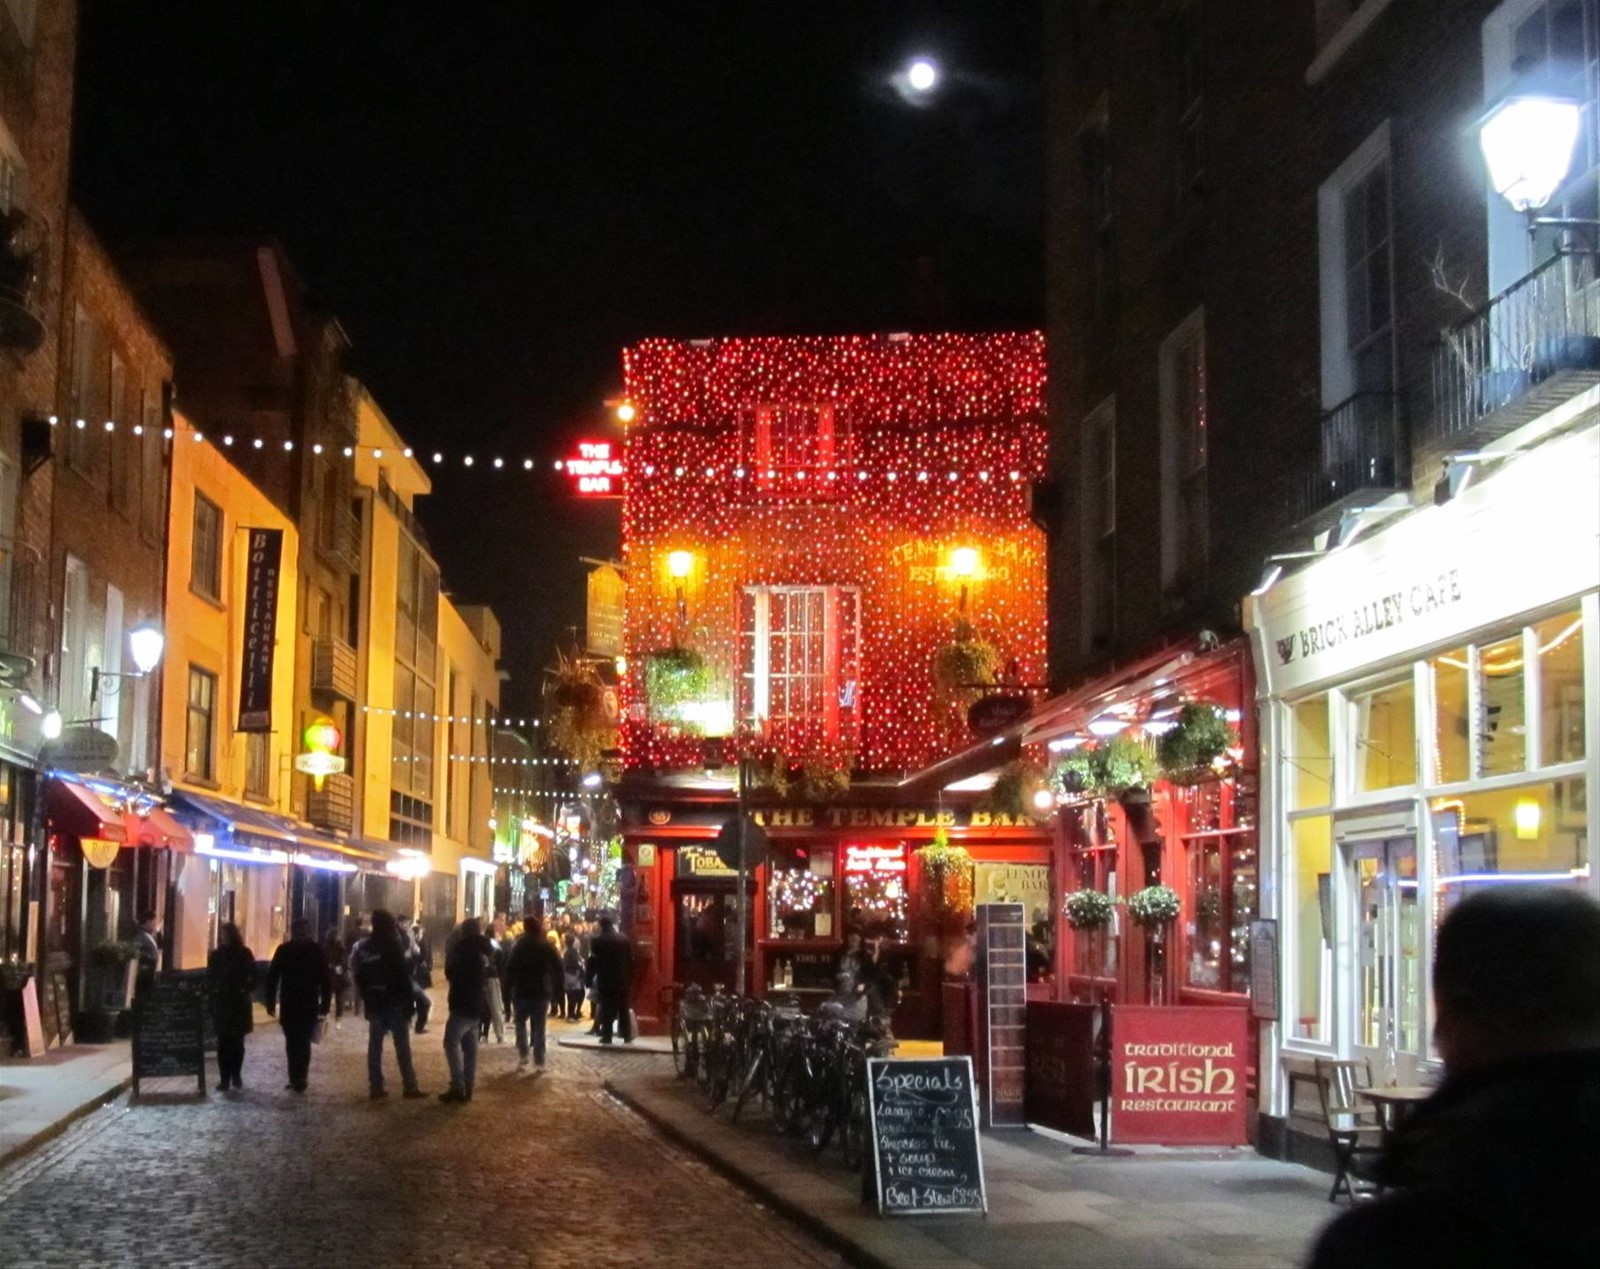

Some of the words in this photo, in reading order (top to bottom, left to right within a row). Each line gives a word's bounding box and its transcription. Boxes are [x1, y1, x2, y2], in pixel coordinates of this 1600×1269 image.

[579, 477, 610, 492] BAR
[248, 533, 267, 708] Botticelli
[1300, 615, 1347, 658] BRICK
[1354, 592, 1403, 639] ALLEY
[828, 808, 956, 827] TEMPLE
[969, 809, 1037, 827] BAR
[876, 1064, 963, 1097] Specials
[886, 1186, 919, 1208] Beef
